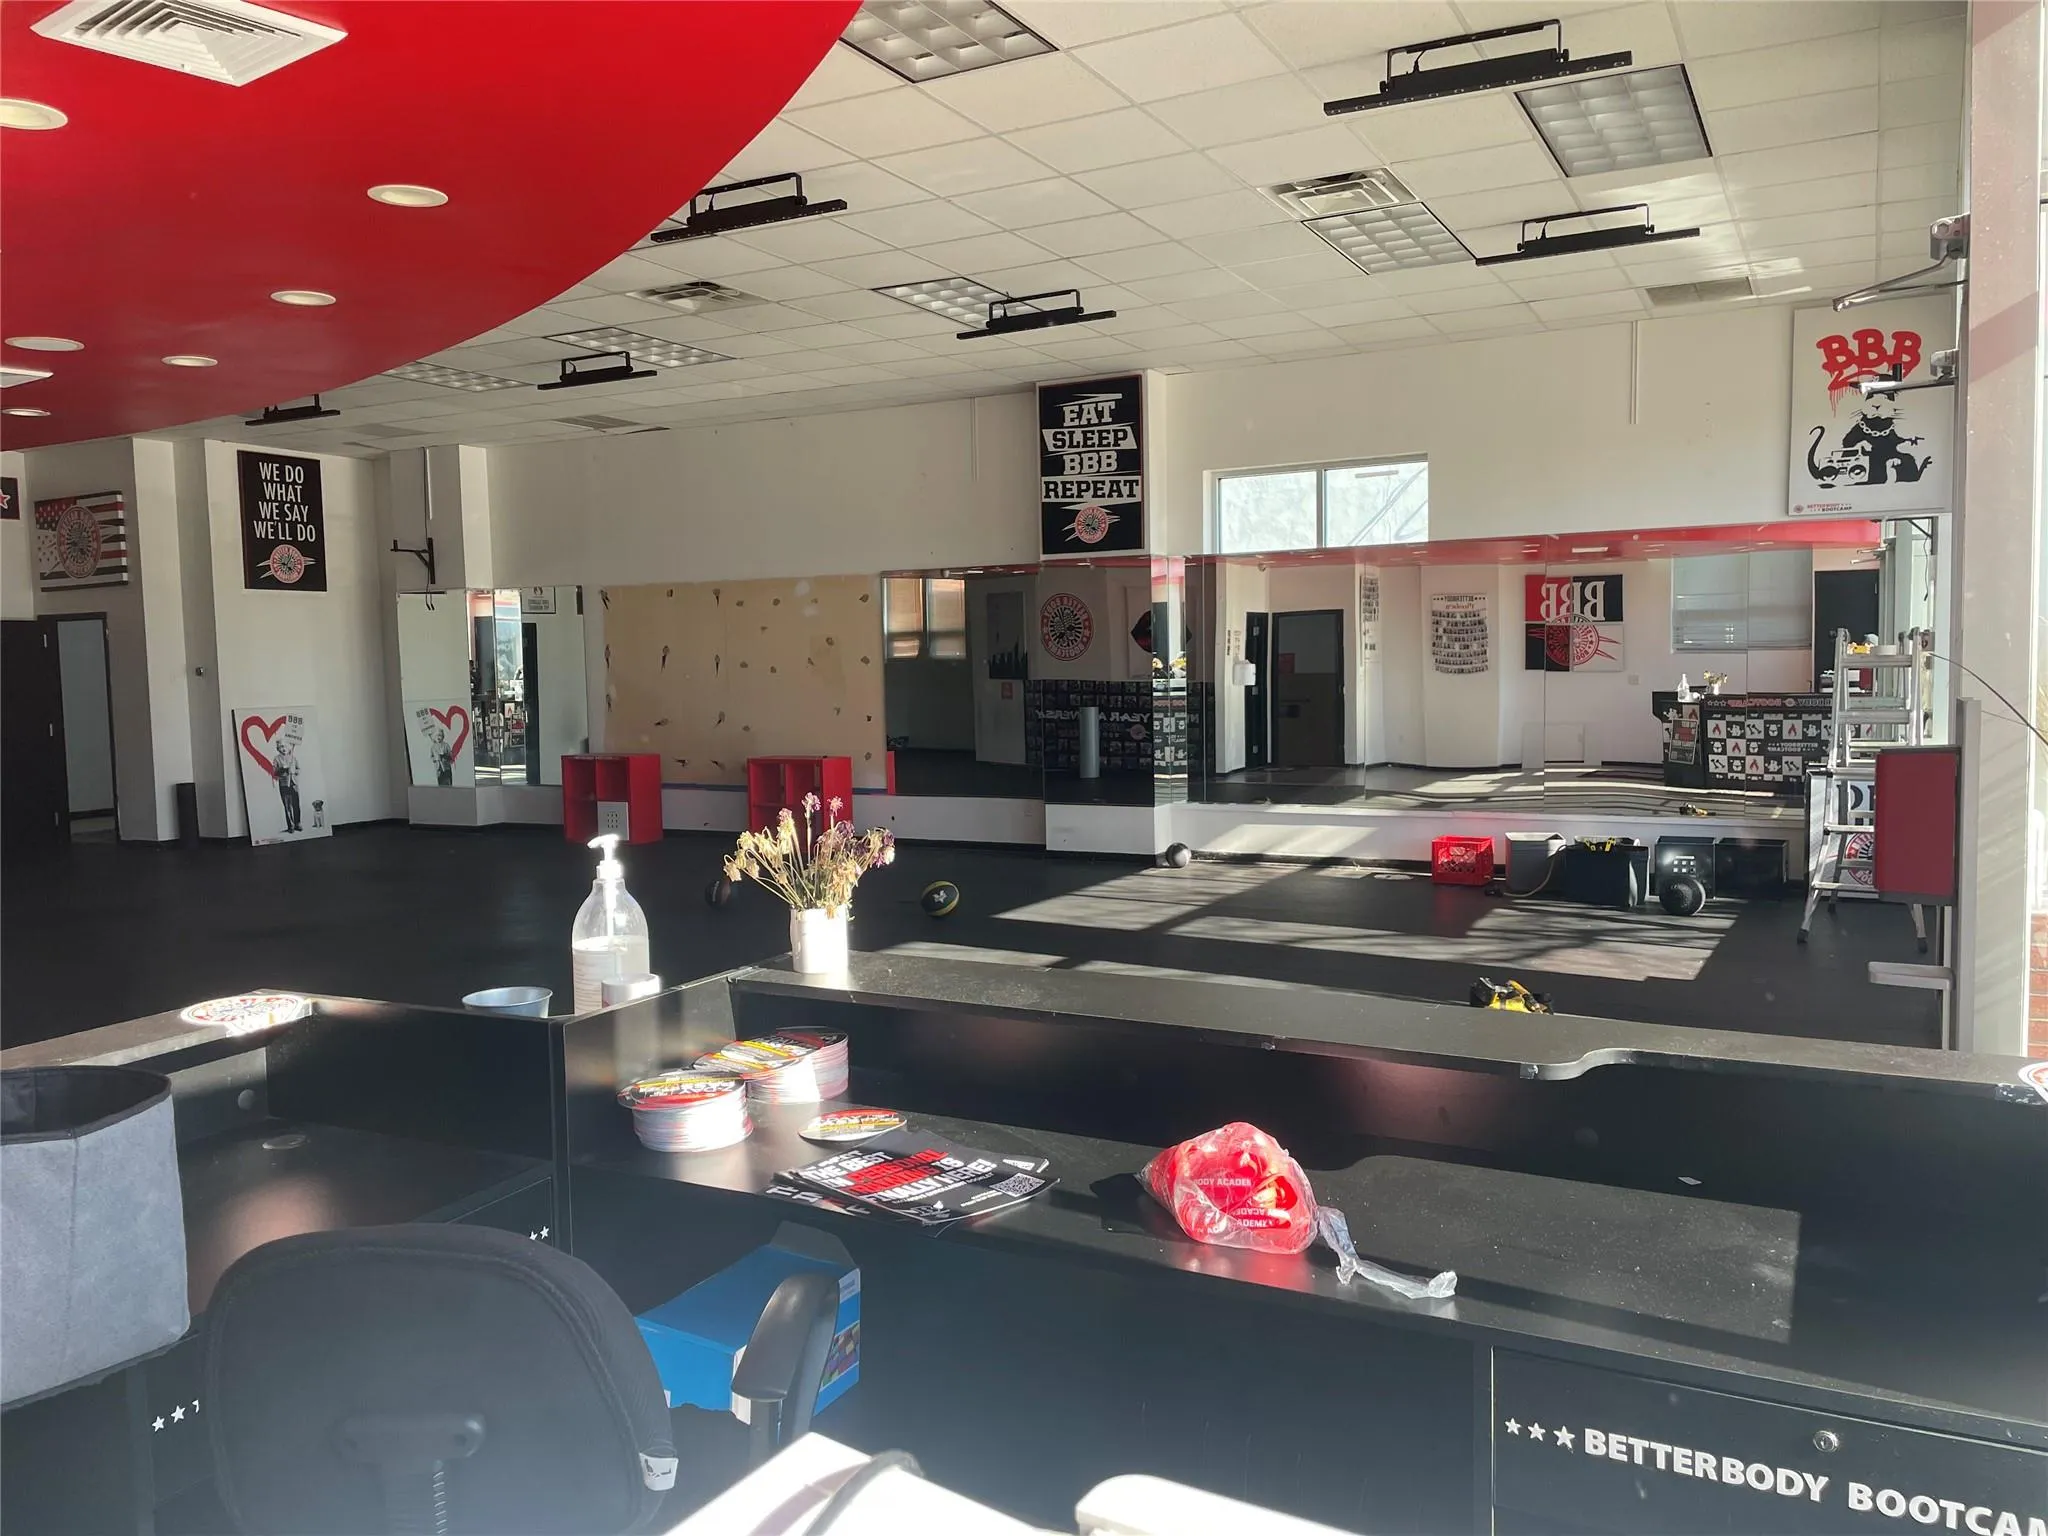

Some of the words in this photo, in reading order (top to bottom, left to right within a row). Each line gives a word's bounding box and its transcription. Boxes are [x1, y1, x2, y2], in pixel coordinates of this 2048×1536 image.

[1816, 328, 1922, 378] BBB
[1063, 400, 1116, 427] EAT
[1052, 428, 1128, 449] SLEEP
[259, 462, 280, 481] WE
[285, 464, 304, 484] DO
[1063, 450, 1118, 475] BBB
[263, 482, 302, 502] WHAT
[1043, 479, 1139, 499] REPEAT
[258, 501, 280, 520] WE
[284, 503, 309, 522] SAY
[253, 520, 293, 541] WE'LL
[297, 524, 316, 542] DO
[799, 1166, 848, 1180] THE
[838, 1151, 894, 1172] BEST
[846, 1148, 950, 1182] PERSONAL
[931, 1157, 965, 1172] IS
[858, 1177, 942, 1203] FINALLY
[933, 1158, 998, 1185] HERE!
[1584, 1428, 1829, 1502] BETTERBODY
